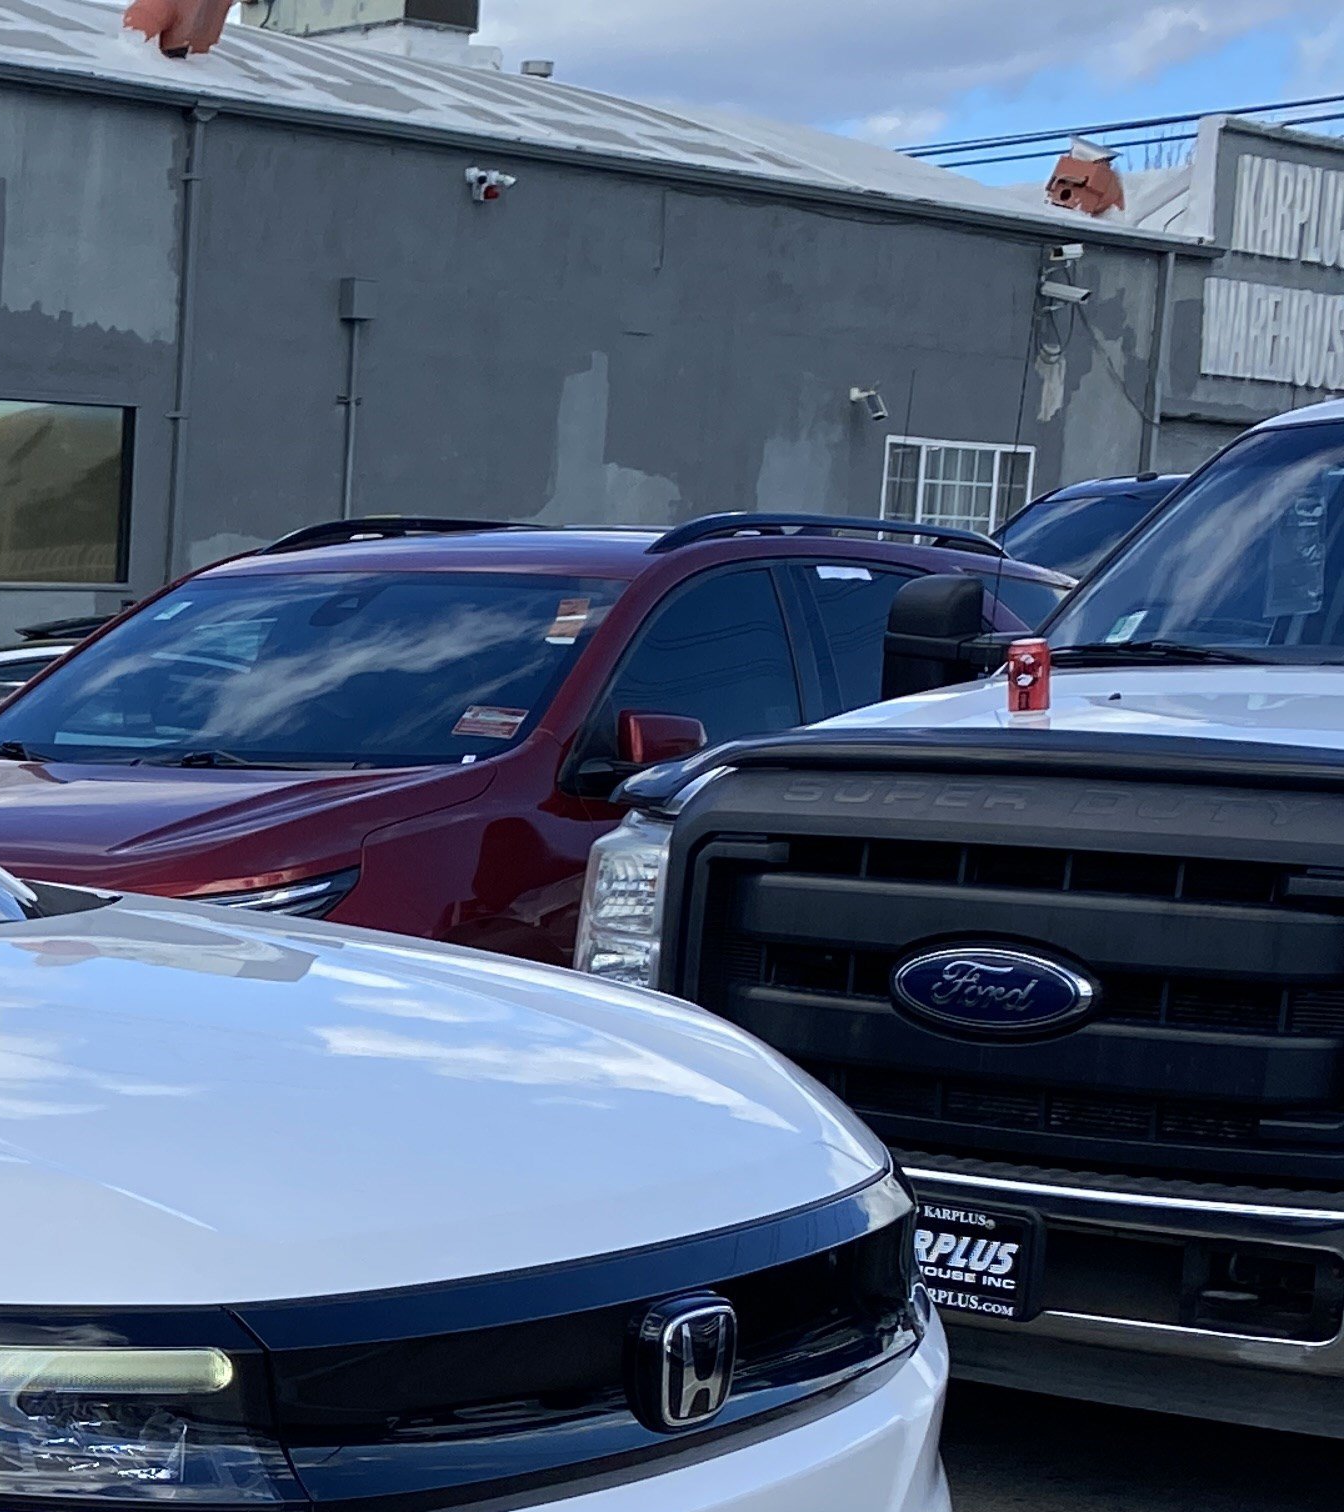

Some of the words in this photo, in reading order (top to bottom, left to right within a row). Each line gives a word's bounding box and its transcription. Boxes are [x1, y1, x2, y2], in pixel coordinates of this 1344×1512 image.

[1231, 154, 1344, 268] KARPLU
[783, 777, 1034, 810] SUPER
[1070, 786, 1320, 827] DUTY
[931, 960, 1039, 1012] Ford
[924, 1205, 986, 1226] KARPLUS
[983, 1275, 1016, 1289] INC
